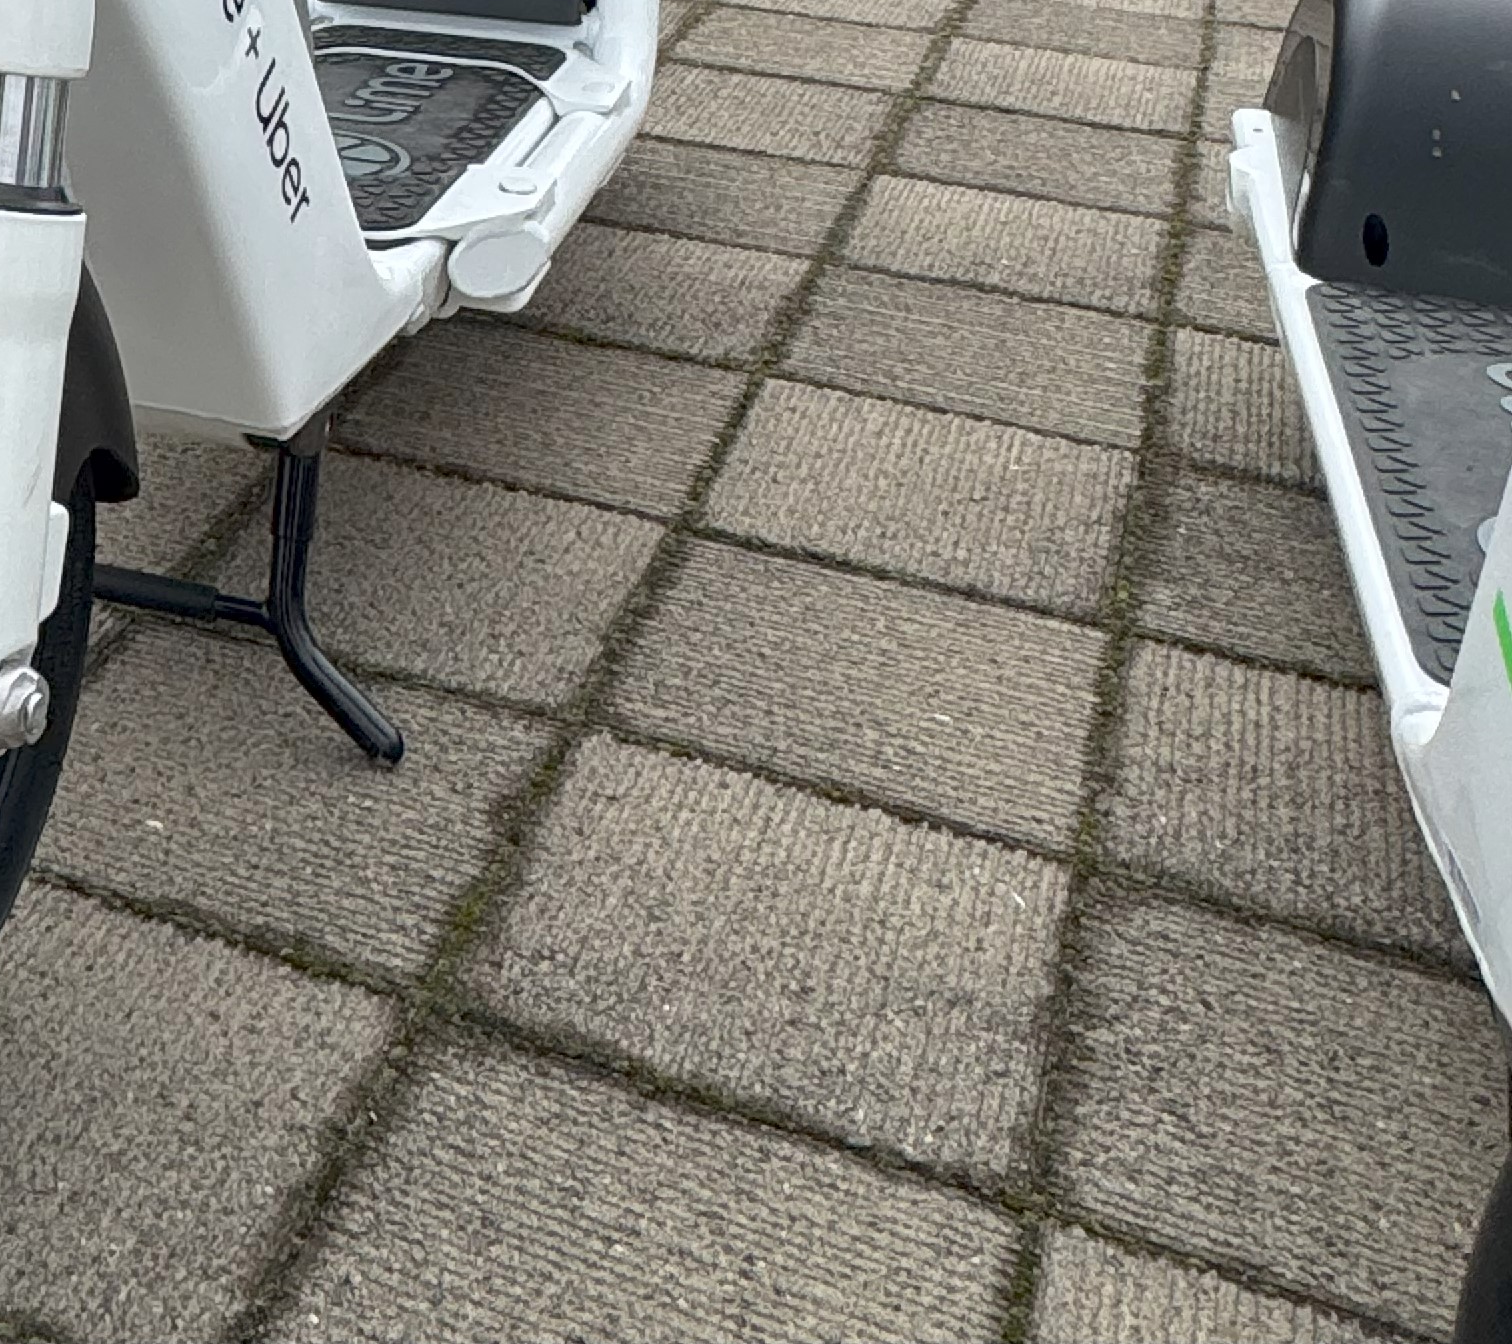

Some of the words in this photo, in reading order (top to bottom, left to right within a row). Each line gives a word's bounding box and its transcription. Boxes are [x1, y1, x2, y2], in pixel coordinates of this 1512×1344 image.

[244, 25, 261, 57] +
[254, 57, 310, 224] Uber
[328, 61, 455, 123] Lime
